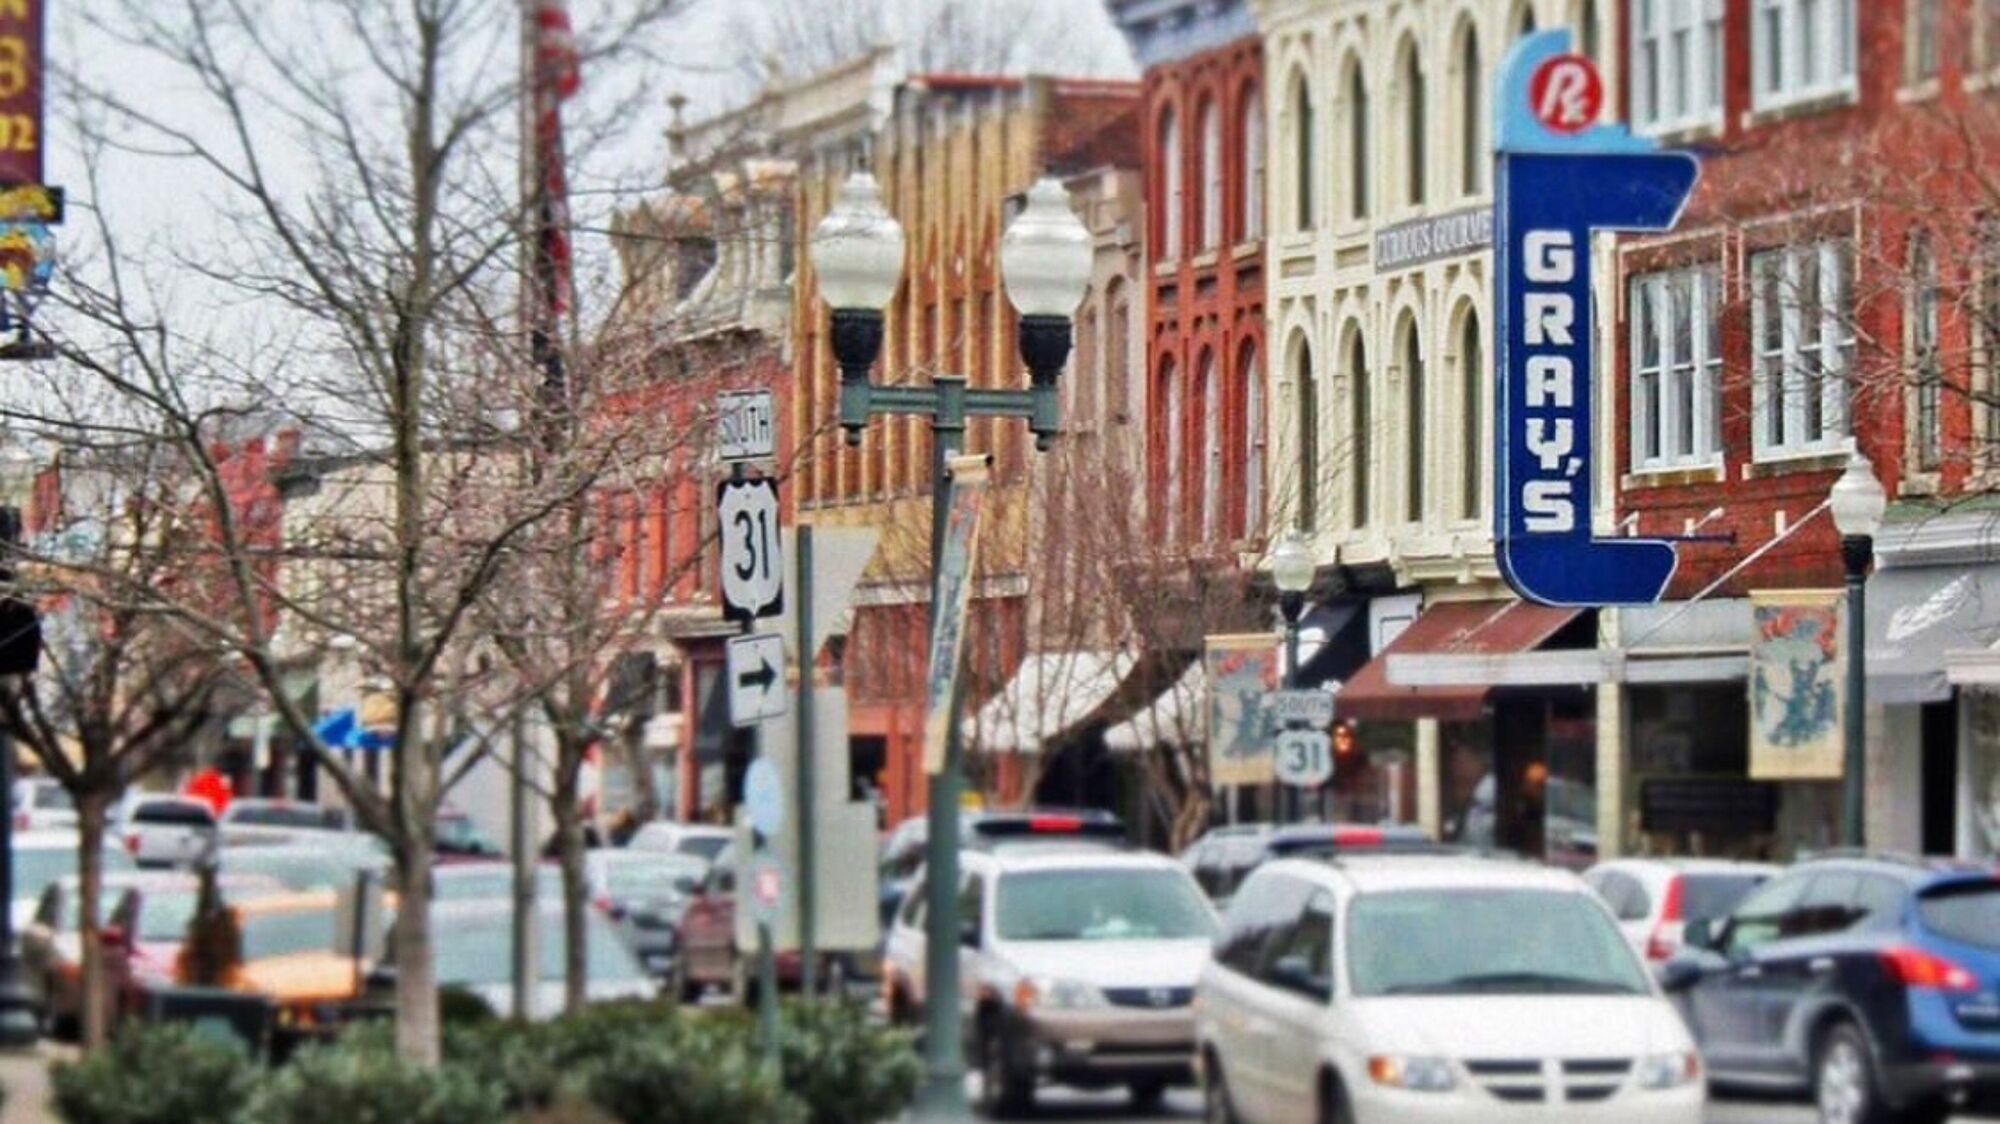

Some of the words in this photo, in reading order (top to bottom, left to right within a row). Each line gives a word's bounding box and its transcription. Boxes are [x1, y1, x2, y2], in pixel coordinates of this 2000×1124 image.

[1523, 230, 1582, 532] GRAY'S
[721, 405, 769, 445] SOUTH
[734, 509, 770, 581] 31
[1279, 695, 1329, 713] SOUTH
[1287, 741, 1320, 773] 31
